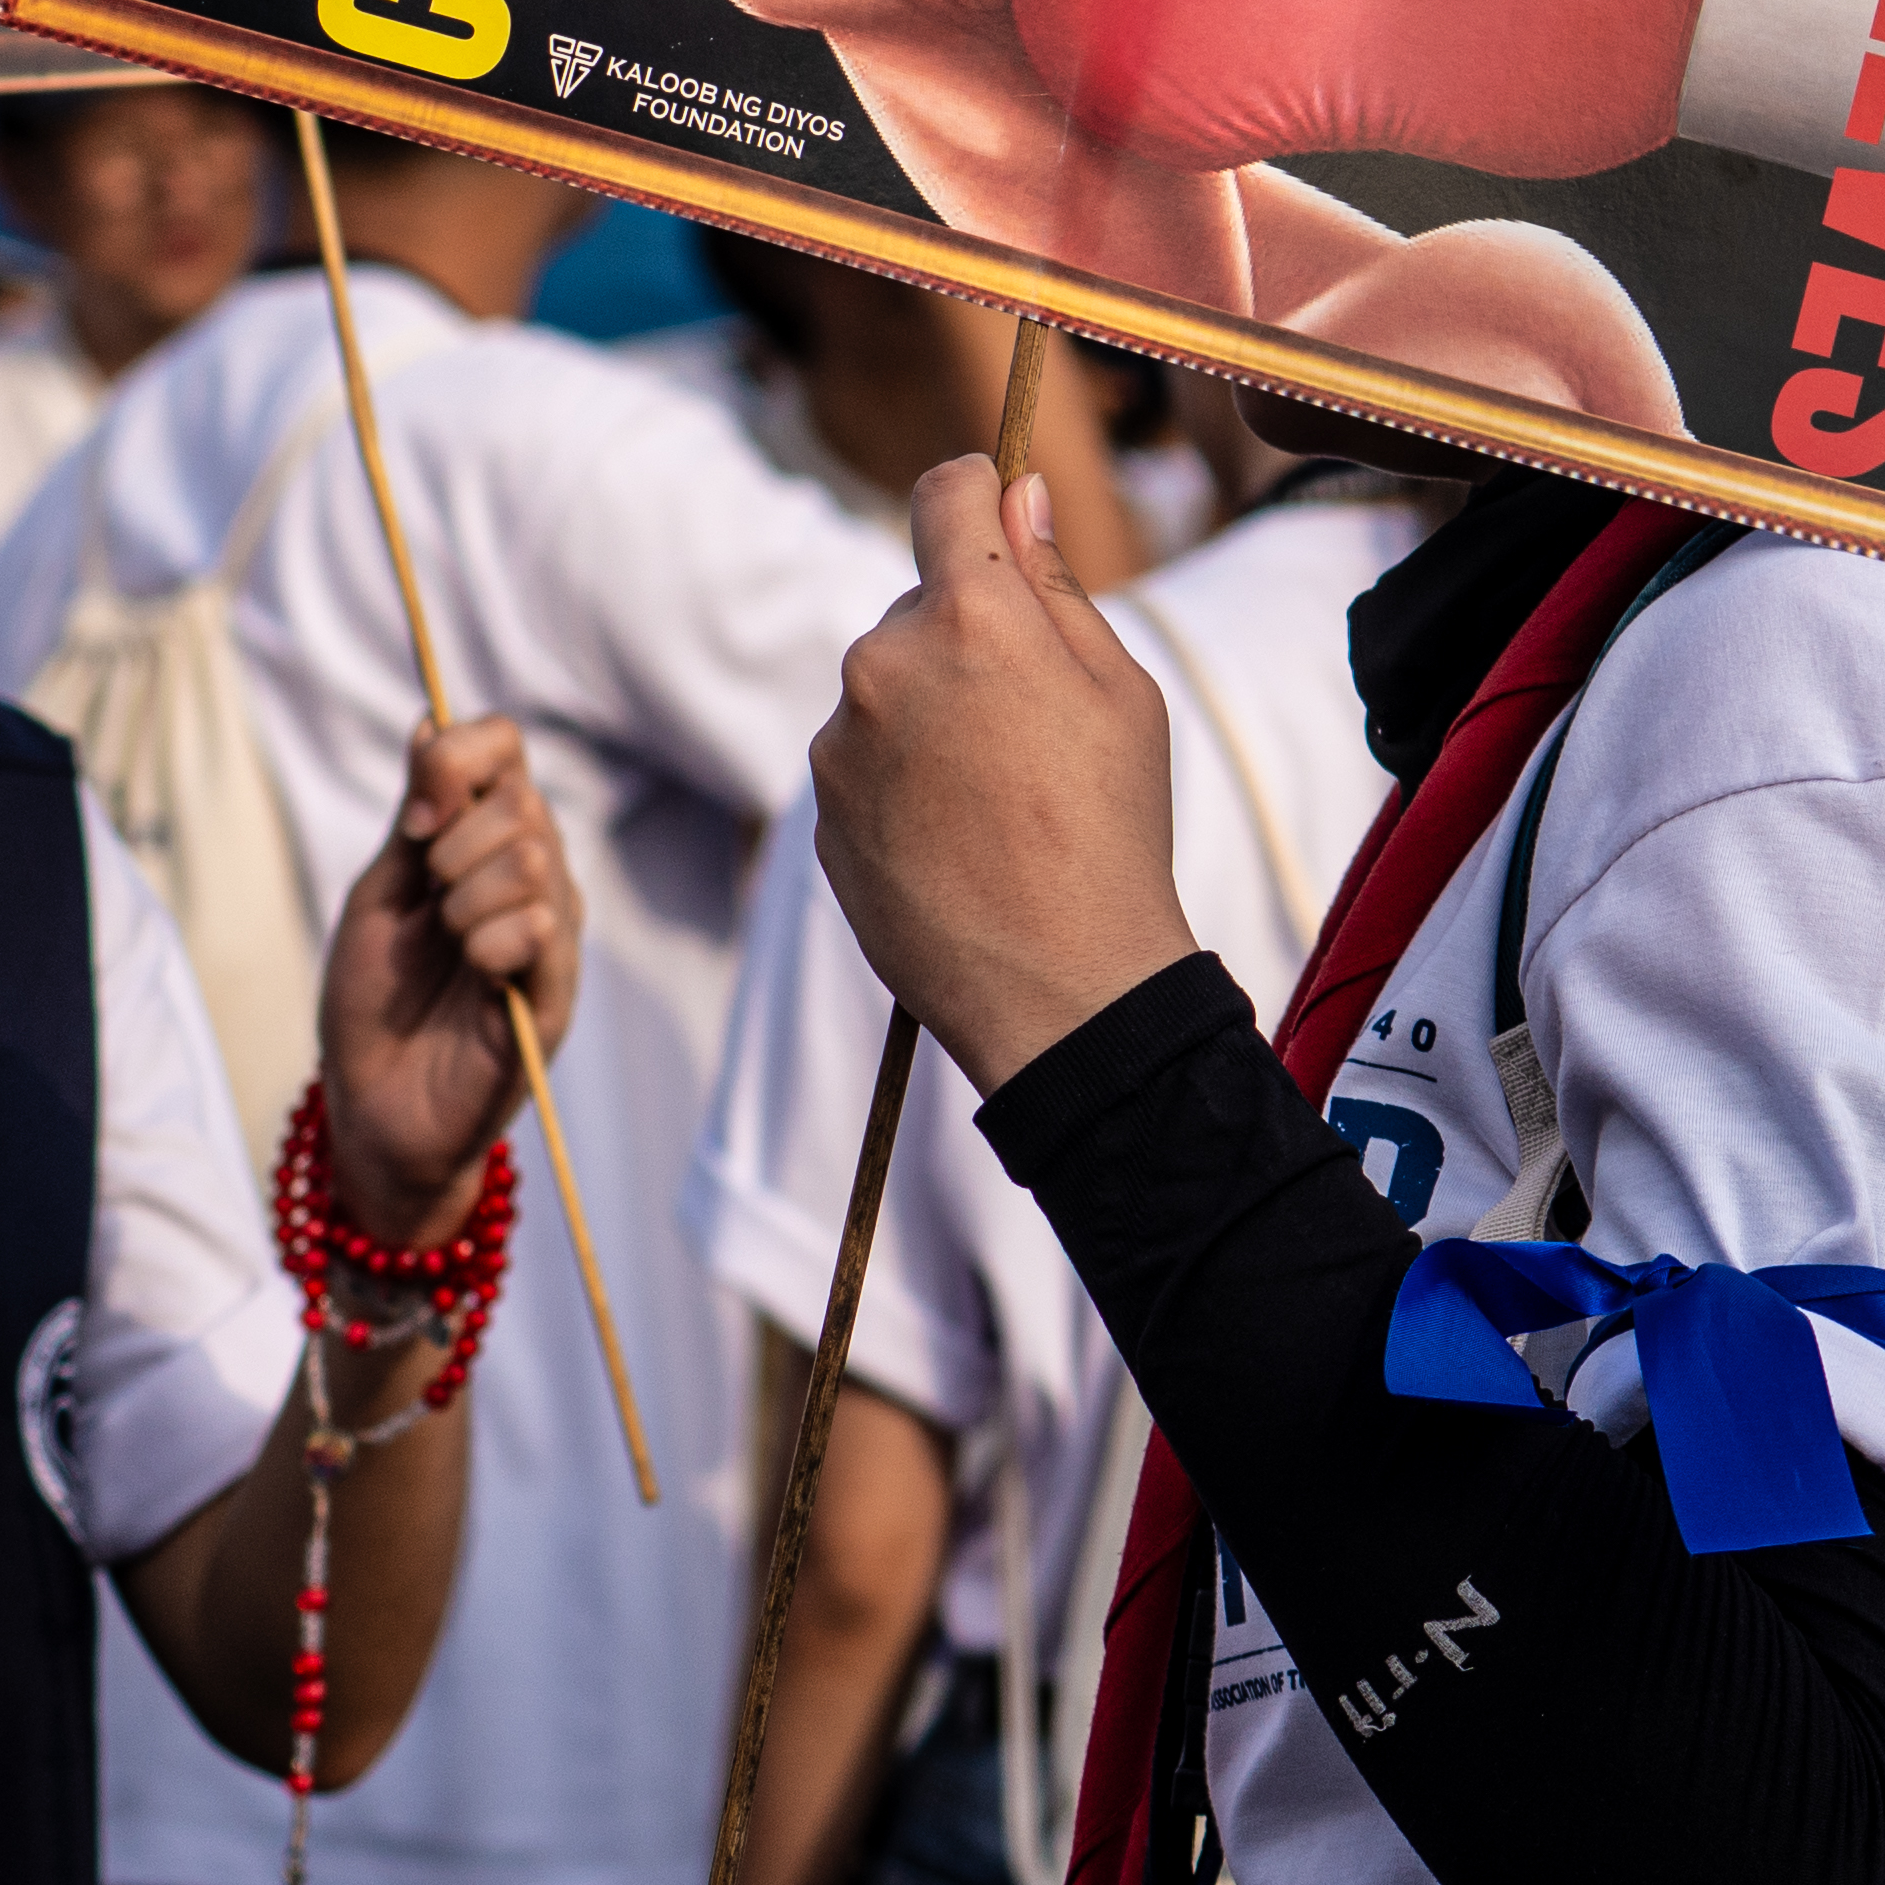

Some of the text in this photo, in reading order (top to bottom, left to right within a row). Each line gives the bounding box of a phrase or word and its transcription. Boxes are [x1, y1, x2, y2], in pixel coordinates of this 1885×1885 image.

[606, 56, 846, 142] KALOOB NG DIYOS
[632, 92, 806, 159] FOUNDATION
